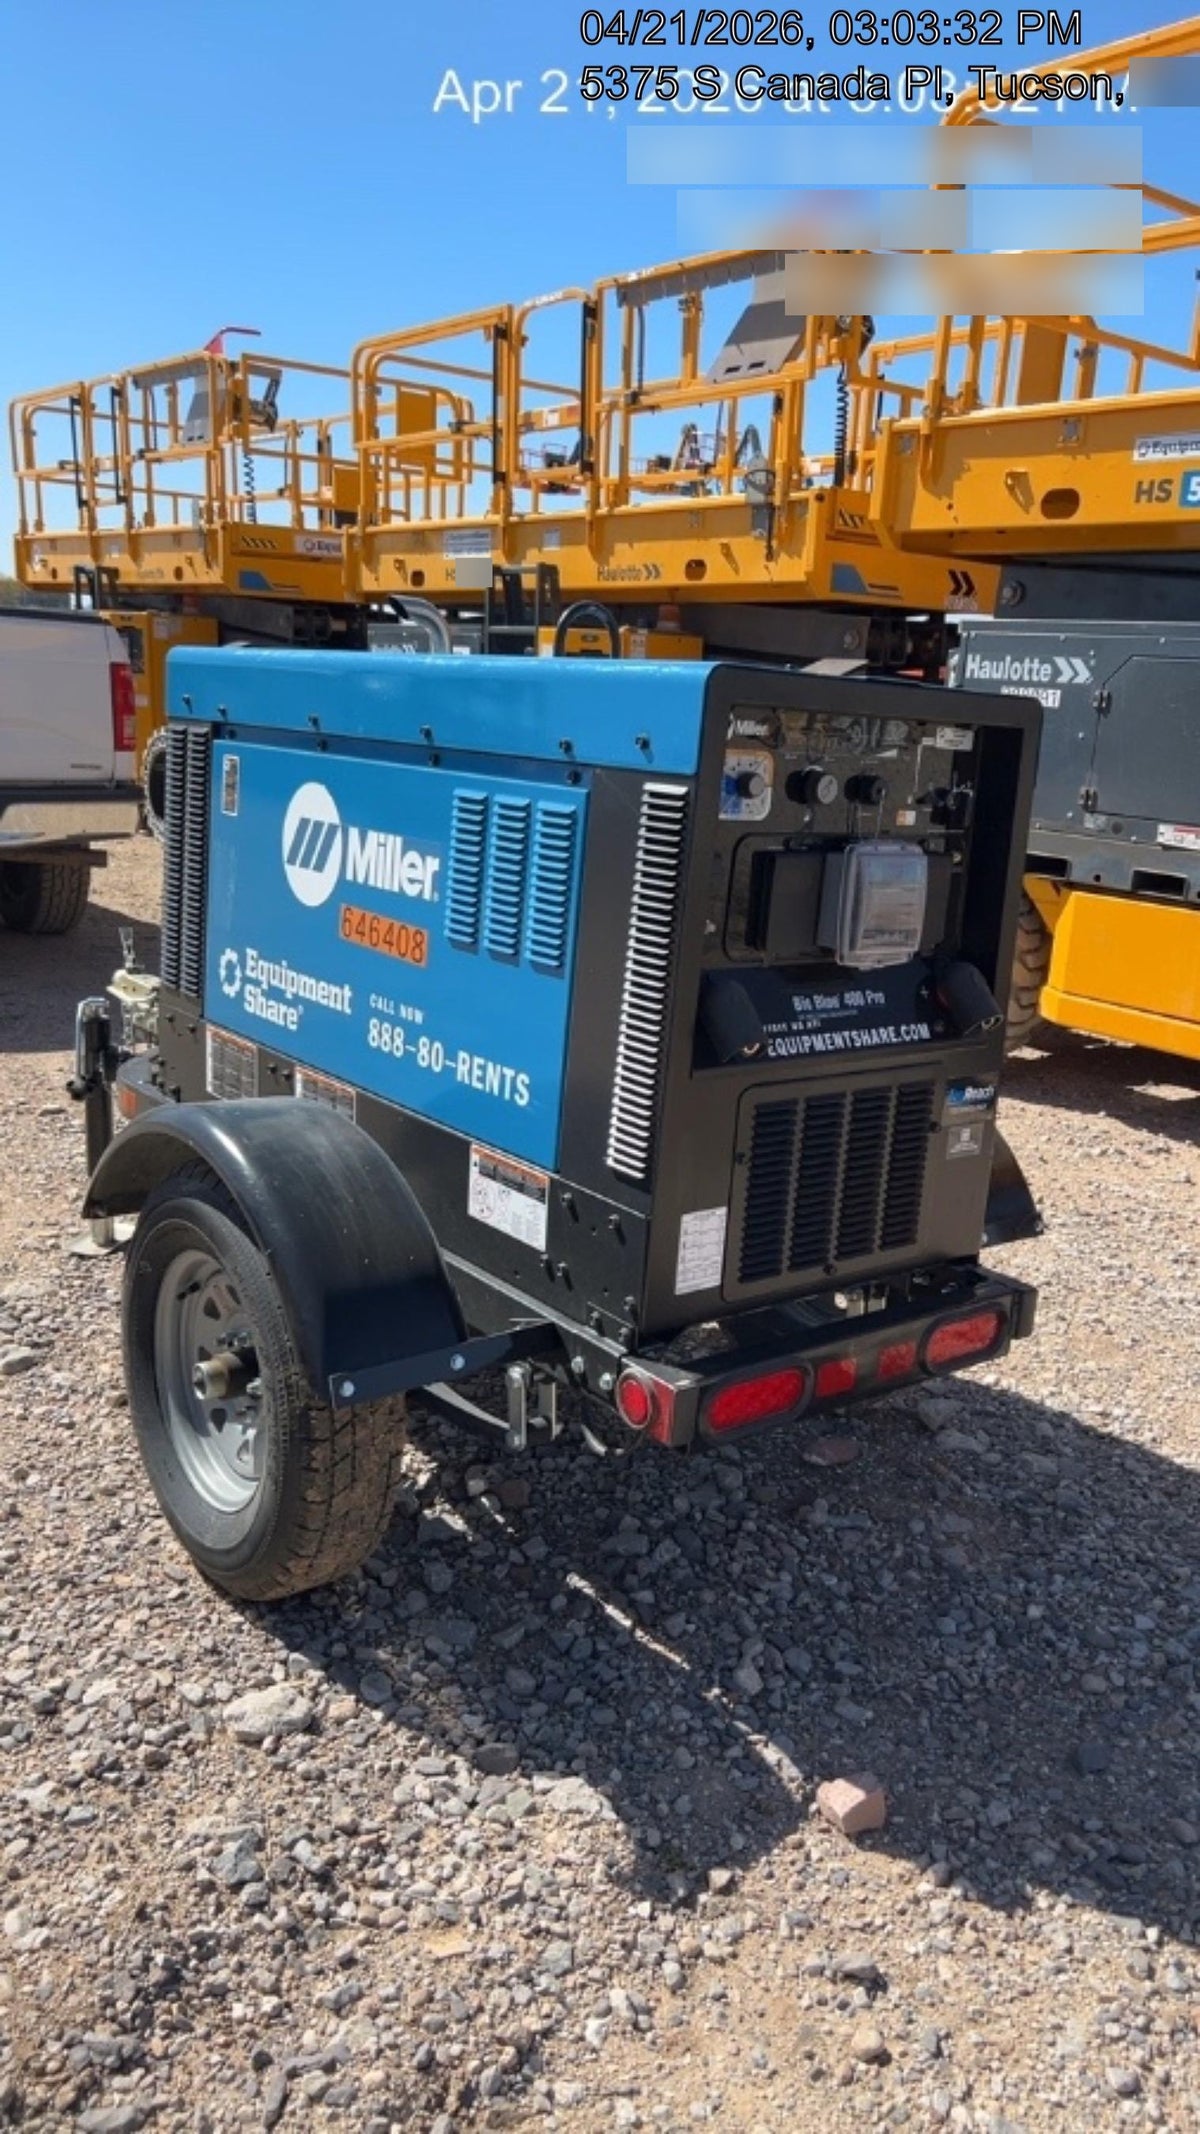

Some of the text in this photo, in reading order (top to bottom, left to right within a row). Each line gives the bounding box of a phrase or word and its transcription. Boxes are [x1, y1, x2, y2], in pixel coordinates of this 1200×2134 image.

[1134, 478, 1173, 503] HS
[965, 653, 1052, 682] Haulotte
[736, 719, 768, 736] Miller
[345, 826, 440, 902] Miller
[342, 907, 425, 964] 646408
[245, 947, 352, 1015] Equipment
[244, 983, 298, 1031] Share
[369, 993, 425, 1025] CALL NOW
[768, 1023, 932, 1057] EQUIPMENTSHARE.COM
[368, 1017, 531, 1107] 888-80-RENTS
